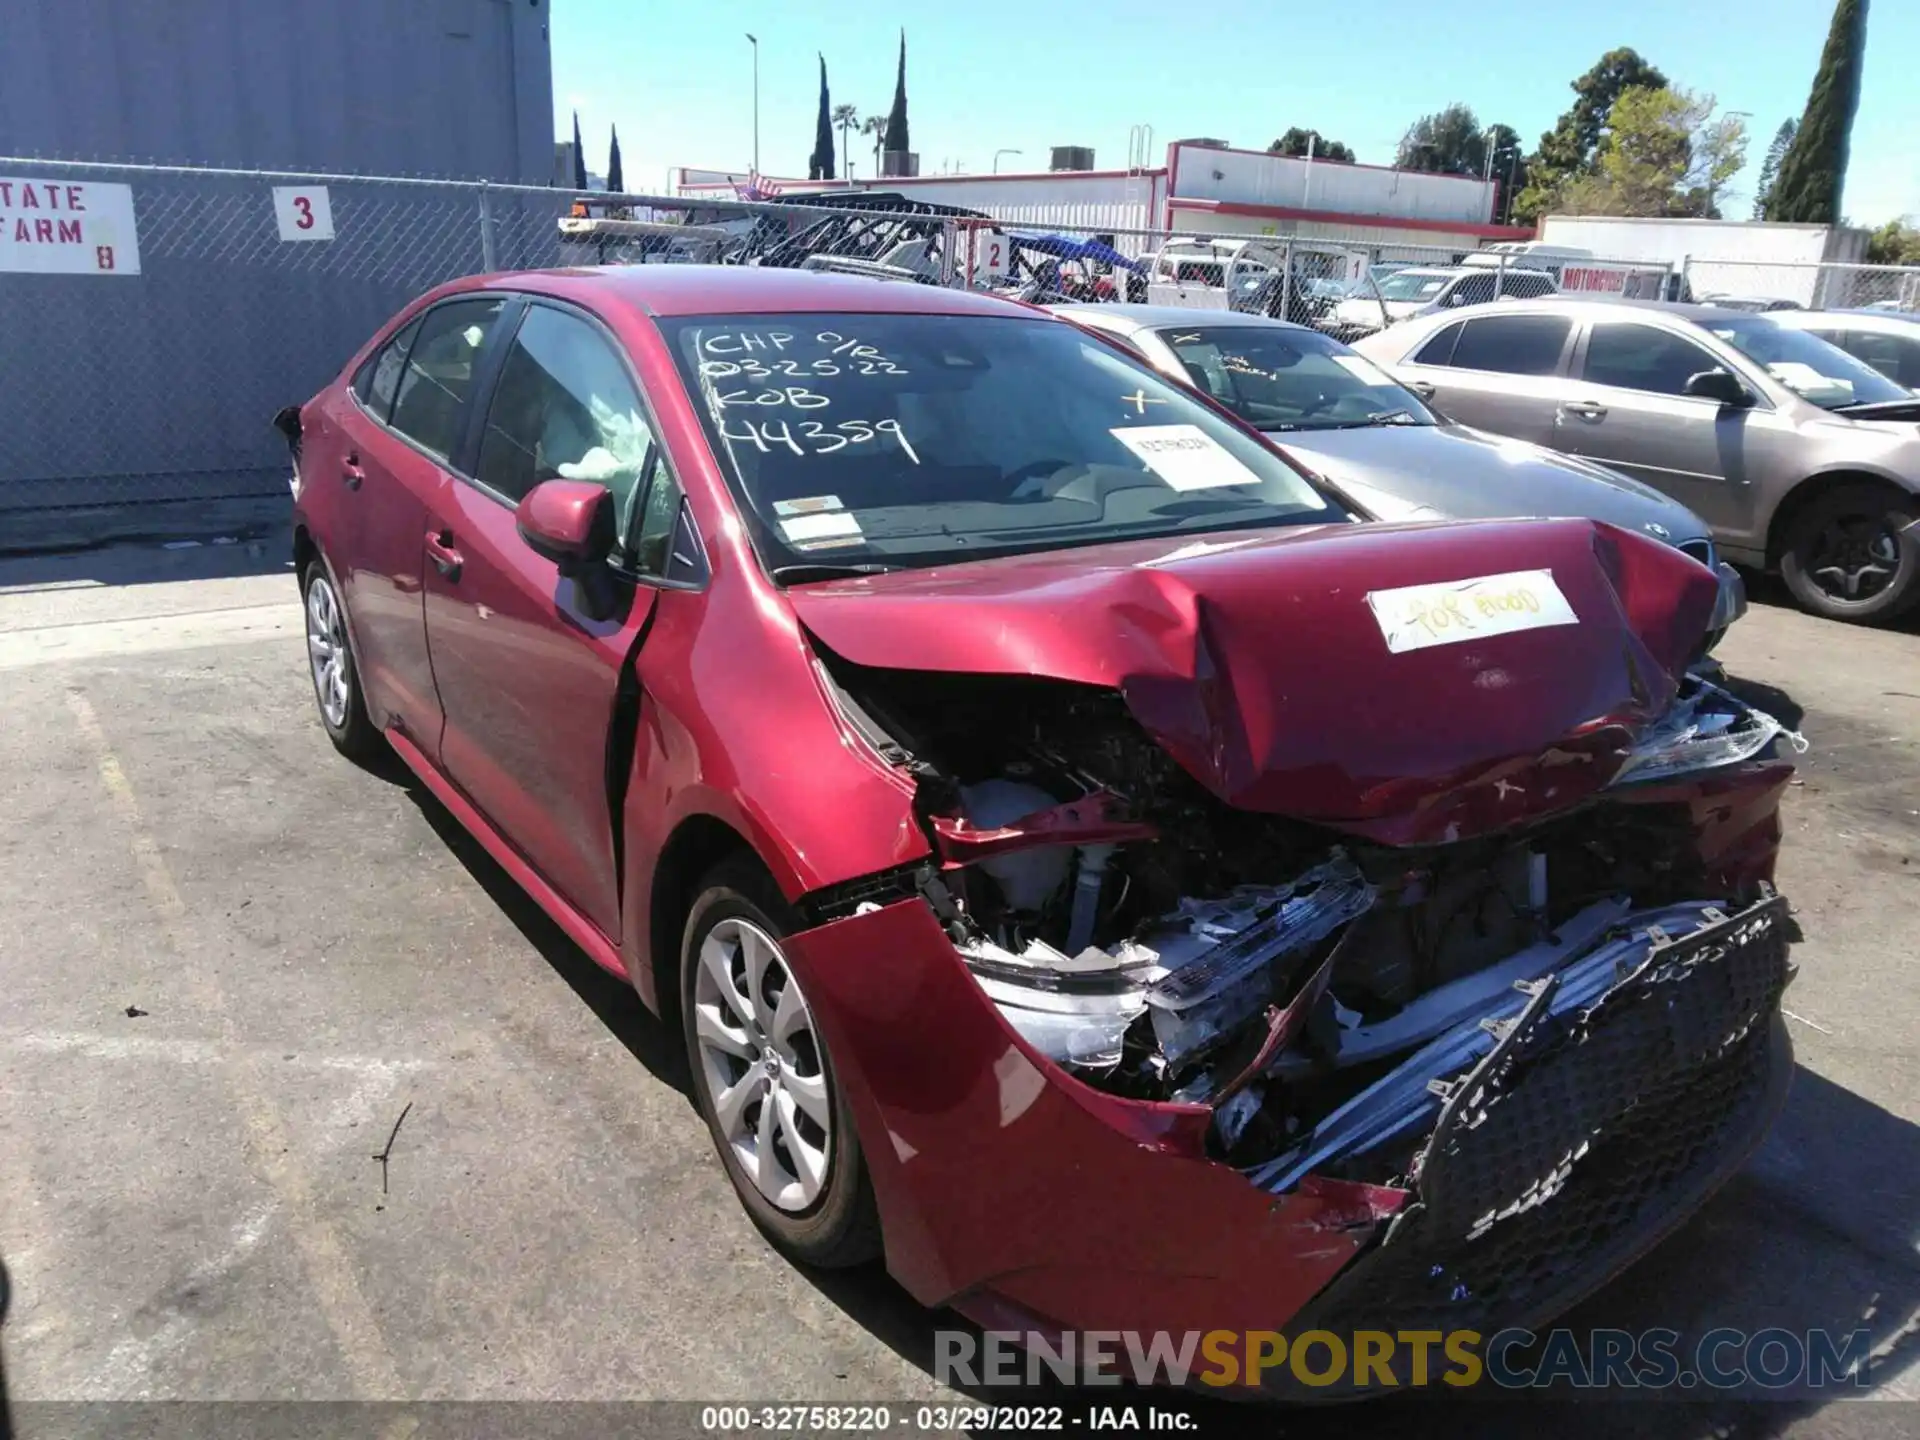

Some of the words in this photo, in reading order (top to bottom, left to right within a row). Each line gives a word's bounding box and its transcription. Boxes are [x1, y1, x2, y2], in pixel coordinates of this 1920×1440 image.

[293, 196, 314, 230] 3
[989, 243, 1000, 267] 2
[1354, 259, 1360, 279] 1
[720, 418, 920, 465] 44359
